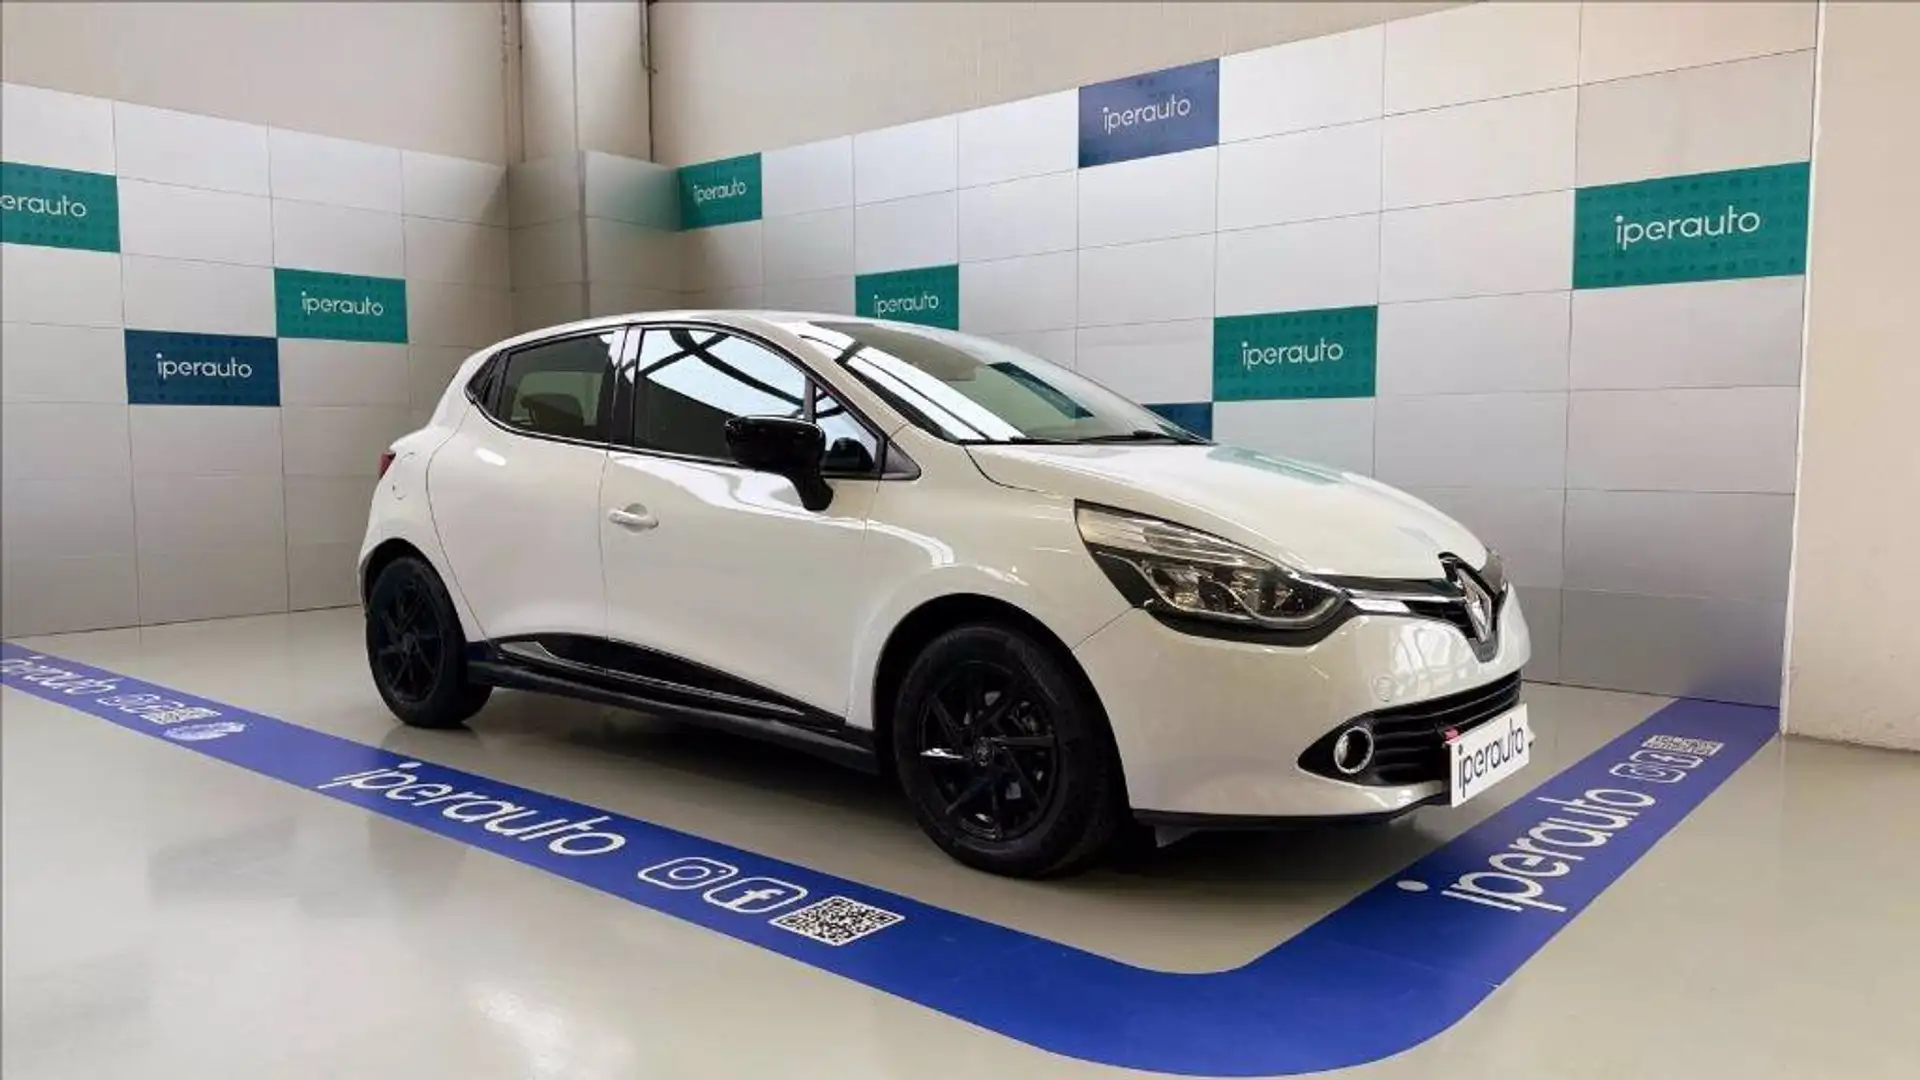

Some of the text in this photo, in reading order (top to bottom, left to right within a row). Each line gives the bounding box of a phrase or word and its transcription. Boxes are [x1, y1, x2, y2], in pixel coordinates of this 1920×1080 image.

[1102, 94, 1191, 134] iperauto
[693, 177, 747, 205] iperauto
[1614, 205, 1760, 250] iperauto
[301, 290, 384, 317] iperauto
[873, 290, 939, 320] iperauto
[156, 353, 253, 380] iperauto
[1242, 338, 1344, 371] iperauto
[1458, 718, 1524, 799] iperauto
[317, 763, 626, 857] iperauto
[1396, 788, 1656, 913] iperauto
